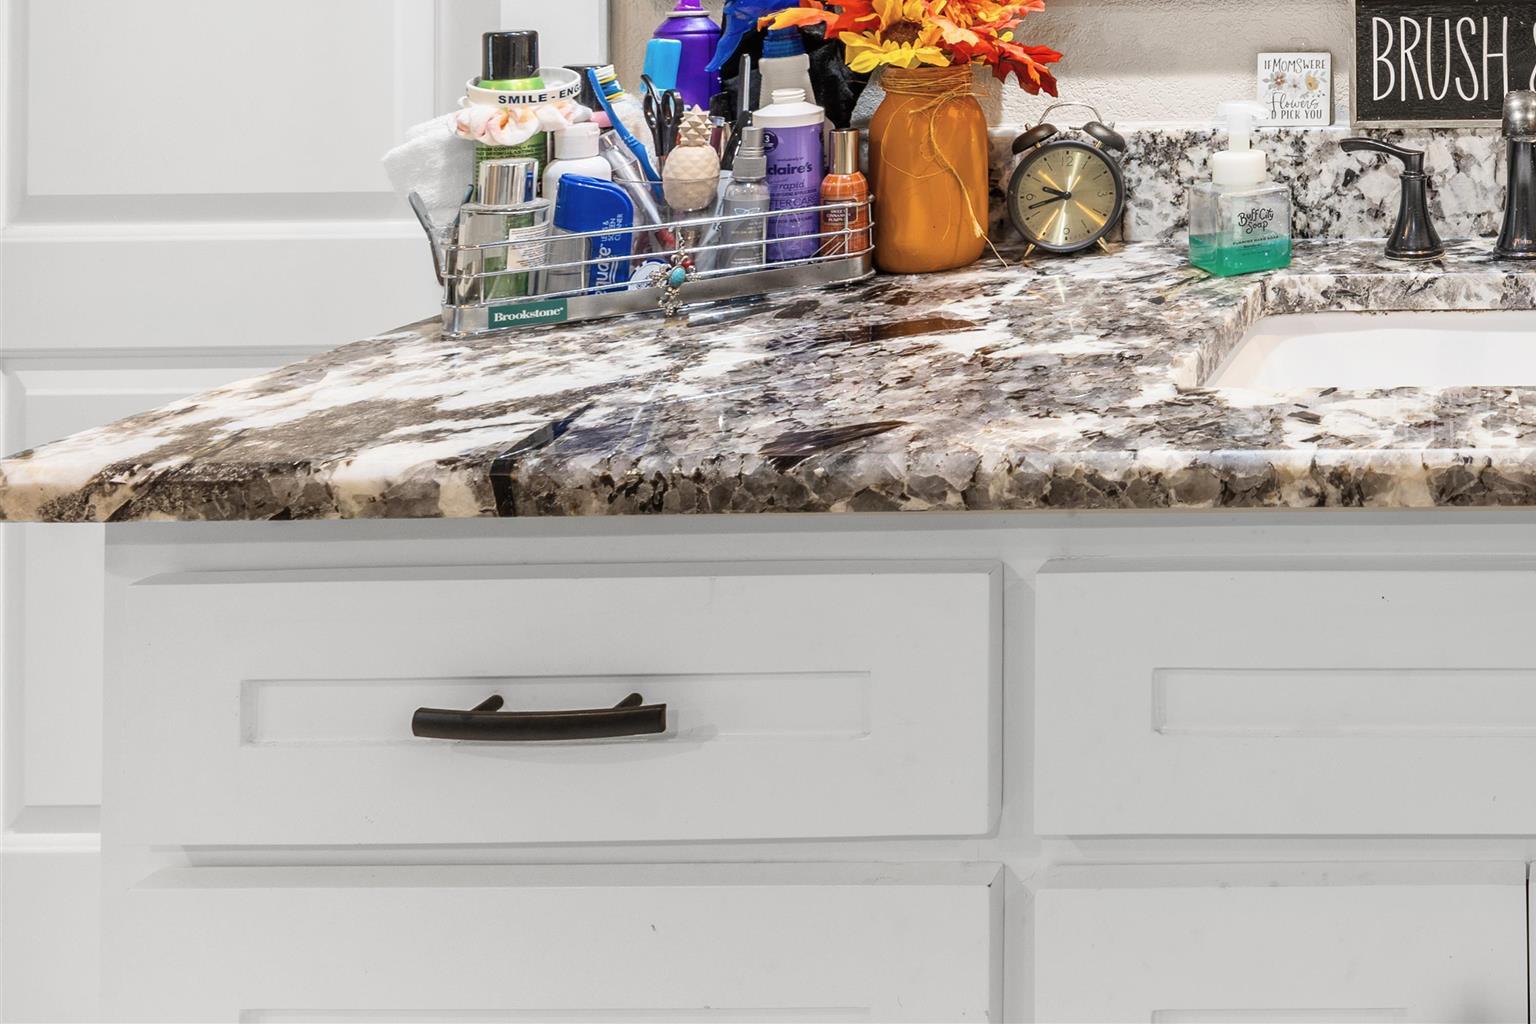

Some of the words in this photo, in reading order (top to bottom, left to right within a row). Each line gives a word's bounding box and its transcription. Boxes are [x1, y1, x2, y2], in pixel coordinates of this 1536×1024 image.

[1264, 60, 1272, 70] IF
[1272, 58, 1303, 73] MOMS
[1303, 59, 1327, 70] WERE
[1372, 15, 1509, 102] BRUSH
[498, 93, 548, 105] SMILE
[1266, 90, 1319, 112] Flowers
[1281, 110, 1301, 120] PICK
[1304, 109, 1322, 120] YOU
[768, 161, 813, 176] claire's
[1061, 156, 1074, 167] 12
[1237, 207, 1259, 227] Buff
[1259, 207, 1274, 221] City
[1246, 220, 1269, 234] Soap
[494, 308, 561, 322] Brookstone
